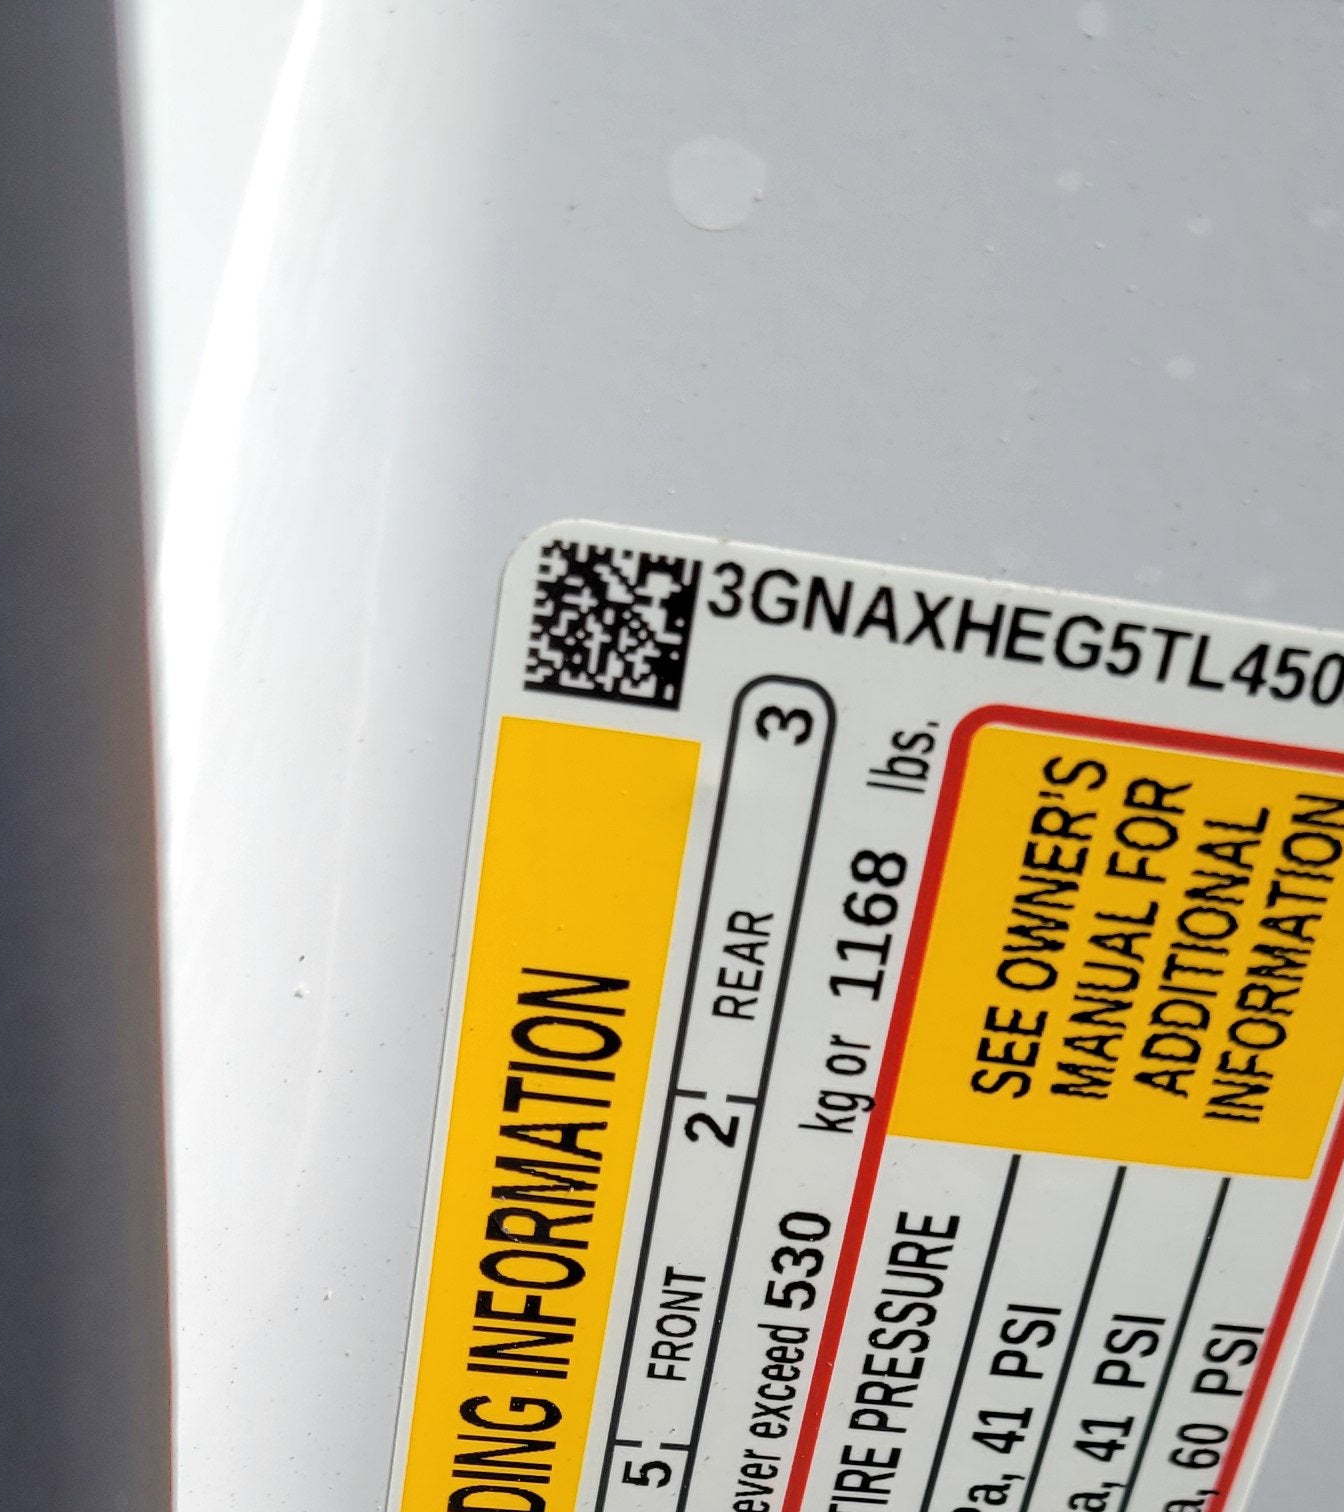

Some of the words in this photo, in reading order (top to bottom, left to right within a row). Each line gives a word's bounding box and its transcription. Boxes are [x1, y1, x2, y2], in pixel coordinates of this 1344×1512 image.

[755, 705, 814, 746] 3
[866, 720, 940, 794] lbs.
[996, 756, 1108, 991] OWNER'S
[829, 849, 908, 1002] 1168
[1050, 900, 1159, 1100] MANUAL
[1105, 777, 1193, 884] FOR
[1133, 806, 1271, 1098] ADDITIONAL
[712, 911, 774, 1020] REAR
[825, 1034, 871, 1077] or
[971, 1005, 1048, 1099] SEE
[684, 1112, 740, 1149] 2
[798, 1089, 876, 1134] kg
[467, 967, 630, 1379] INFORMATION
[764, 1211, 831, 1311] 530
[646, 1266, 706, 1381] FRONT
[848, 1211, 960, 1433] PRESSURE
[989, 1303, 1062, 1379] PSI
[1092, 1314, 1167, 1388] PSI
[1190, 1323, 1265, 1396] PSI
[749, 1323, 810, 1439] exceed
[971, 1407, 1034, 1454] 41
[1073, 1416, 1135, 1462] 41
[1168, 1423, 1229, 1470] 60
[621, 1461, 672, 1488] 5
